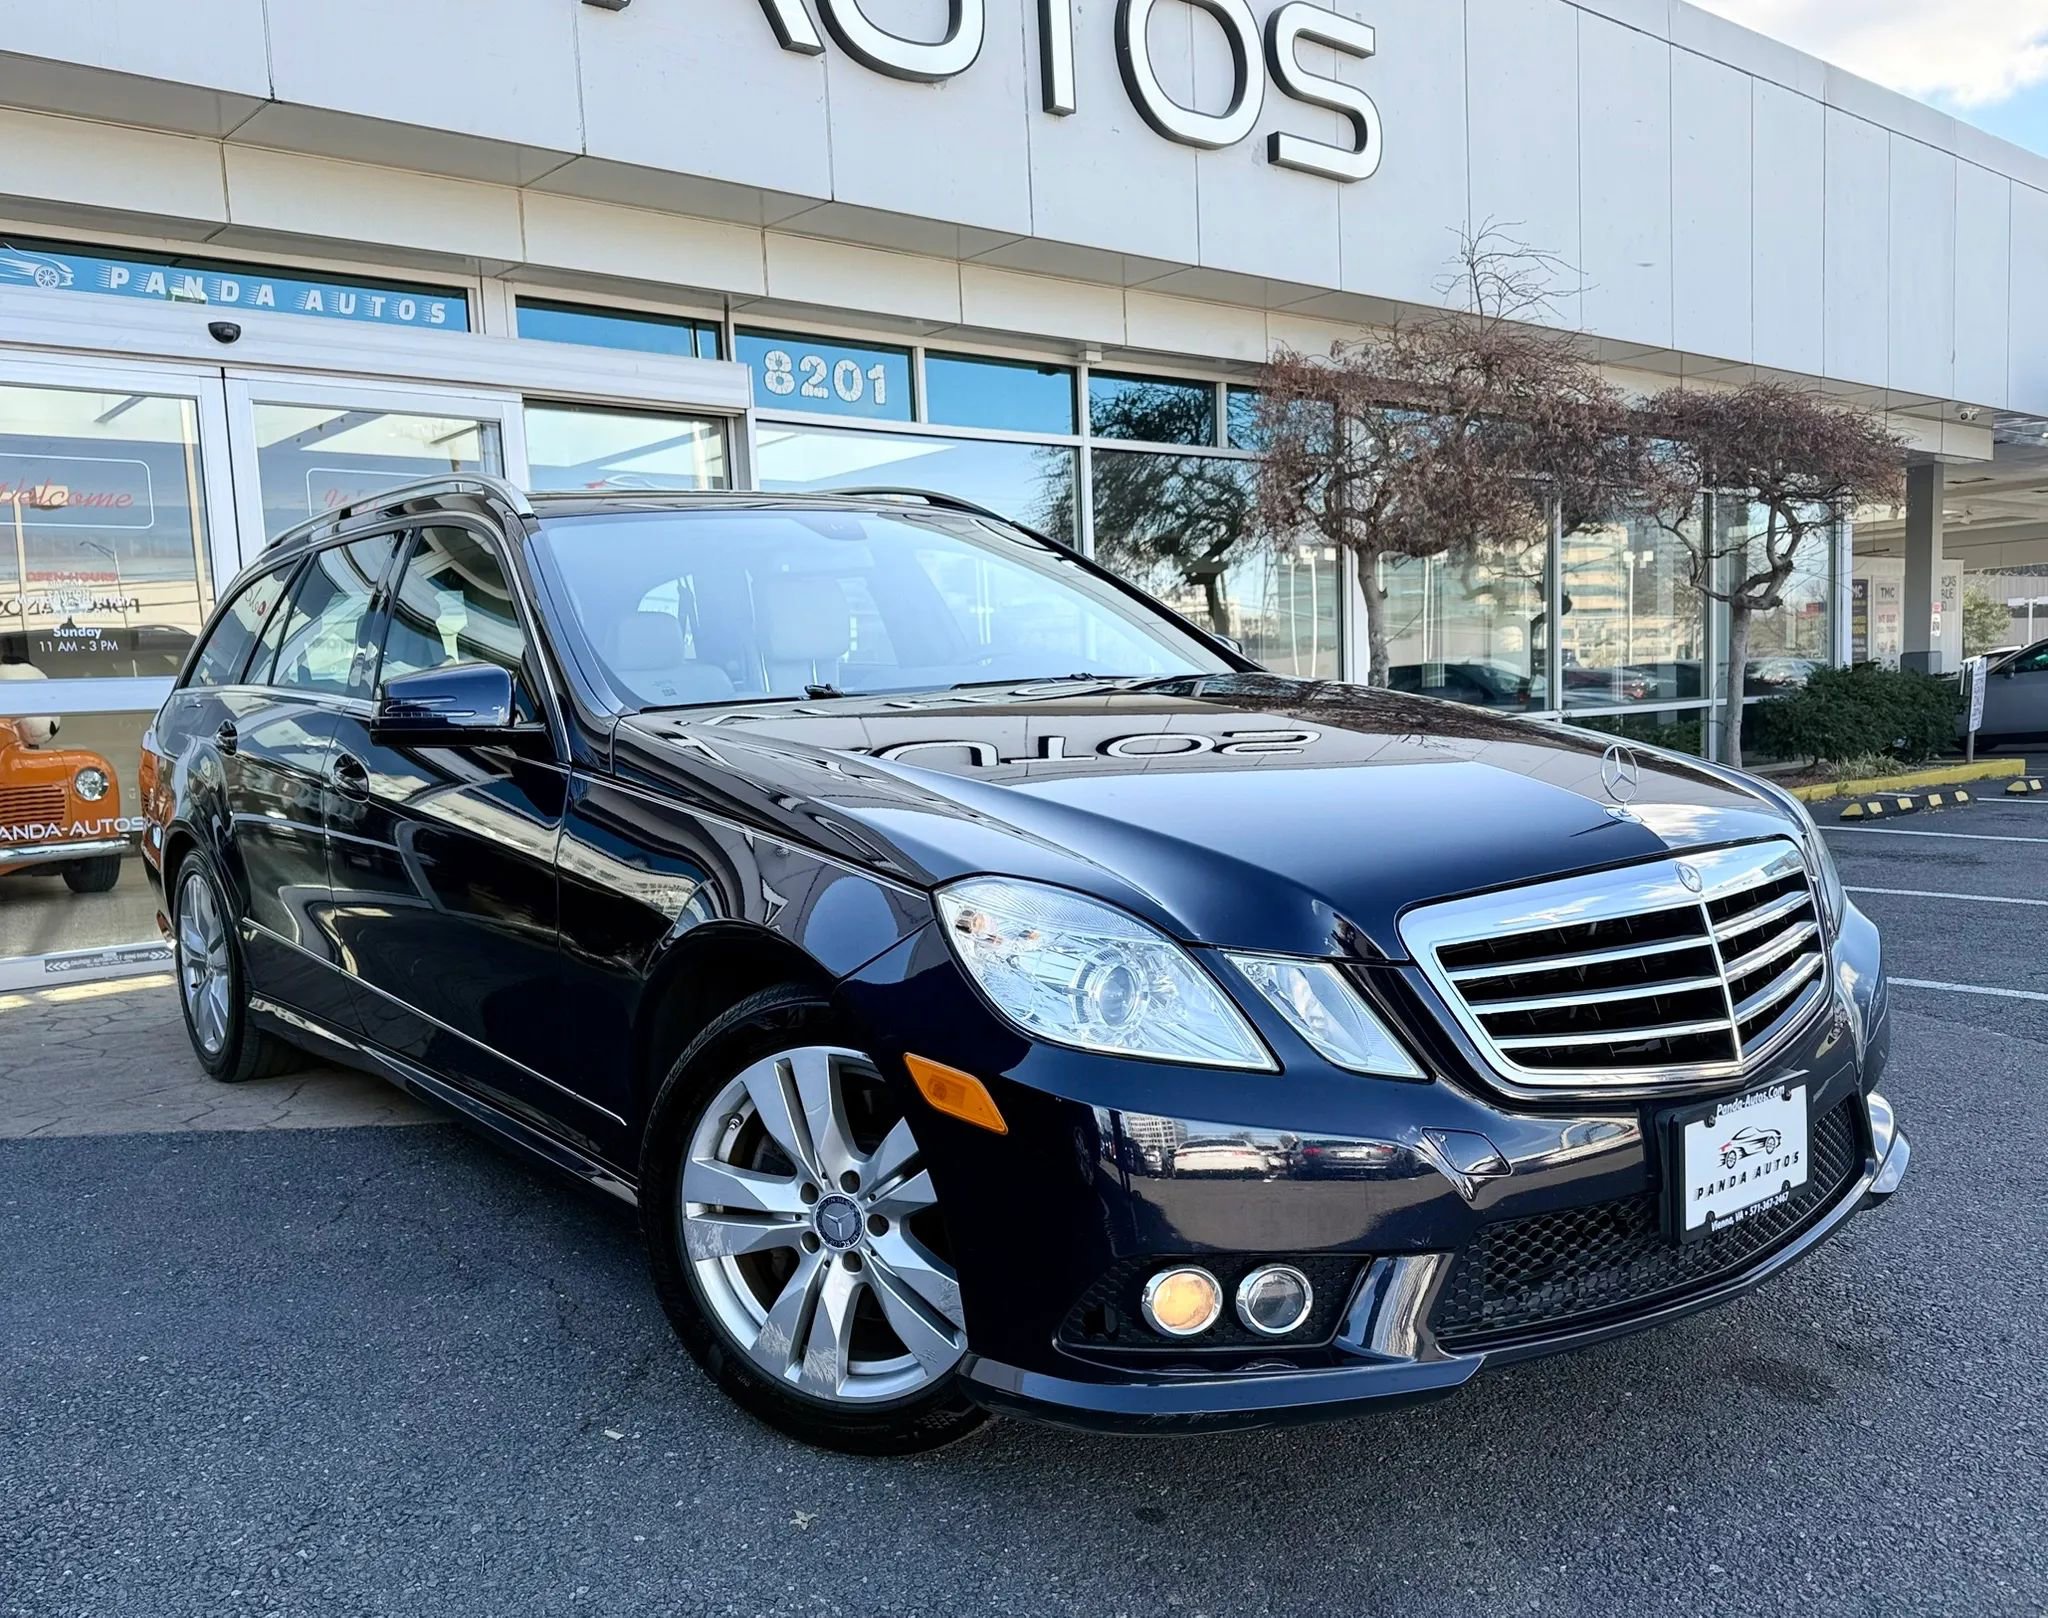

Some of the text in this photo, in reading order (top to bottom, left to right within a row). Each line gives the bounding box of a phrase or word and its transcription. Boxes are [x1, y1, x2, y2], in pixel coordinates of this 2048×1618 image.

[583, 0, 1382, 182] TOS
[98, 265, 446, 324] PANDA AUTOS
[764, 350, 886, 404] 8201
[1881, 587, 1895, 598] TMC
[39, 641, 52, 652] 11
[58, 641, 77, 652] AM
[89, 640, 97, 651] 3
[101, 640, 118, 651] PM
[53, 627, 102, 640] Sunday
[1716, 1085, 1785, 1116] Panda-Autos.Com
[1695, 1151, 1799, 1201] PANDA AUTOS
[1735, 1210, 1744, 1222] VA
